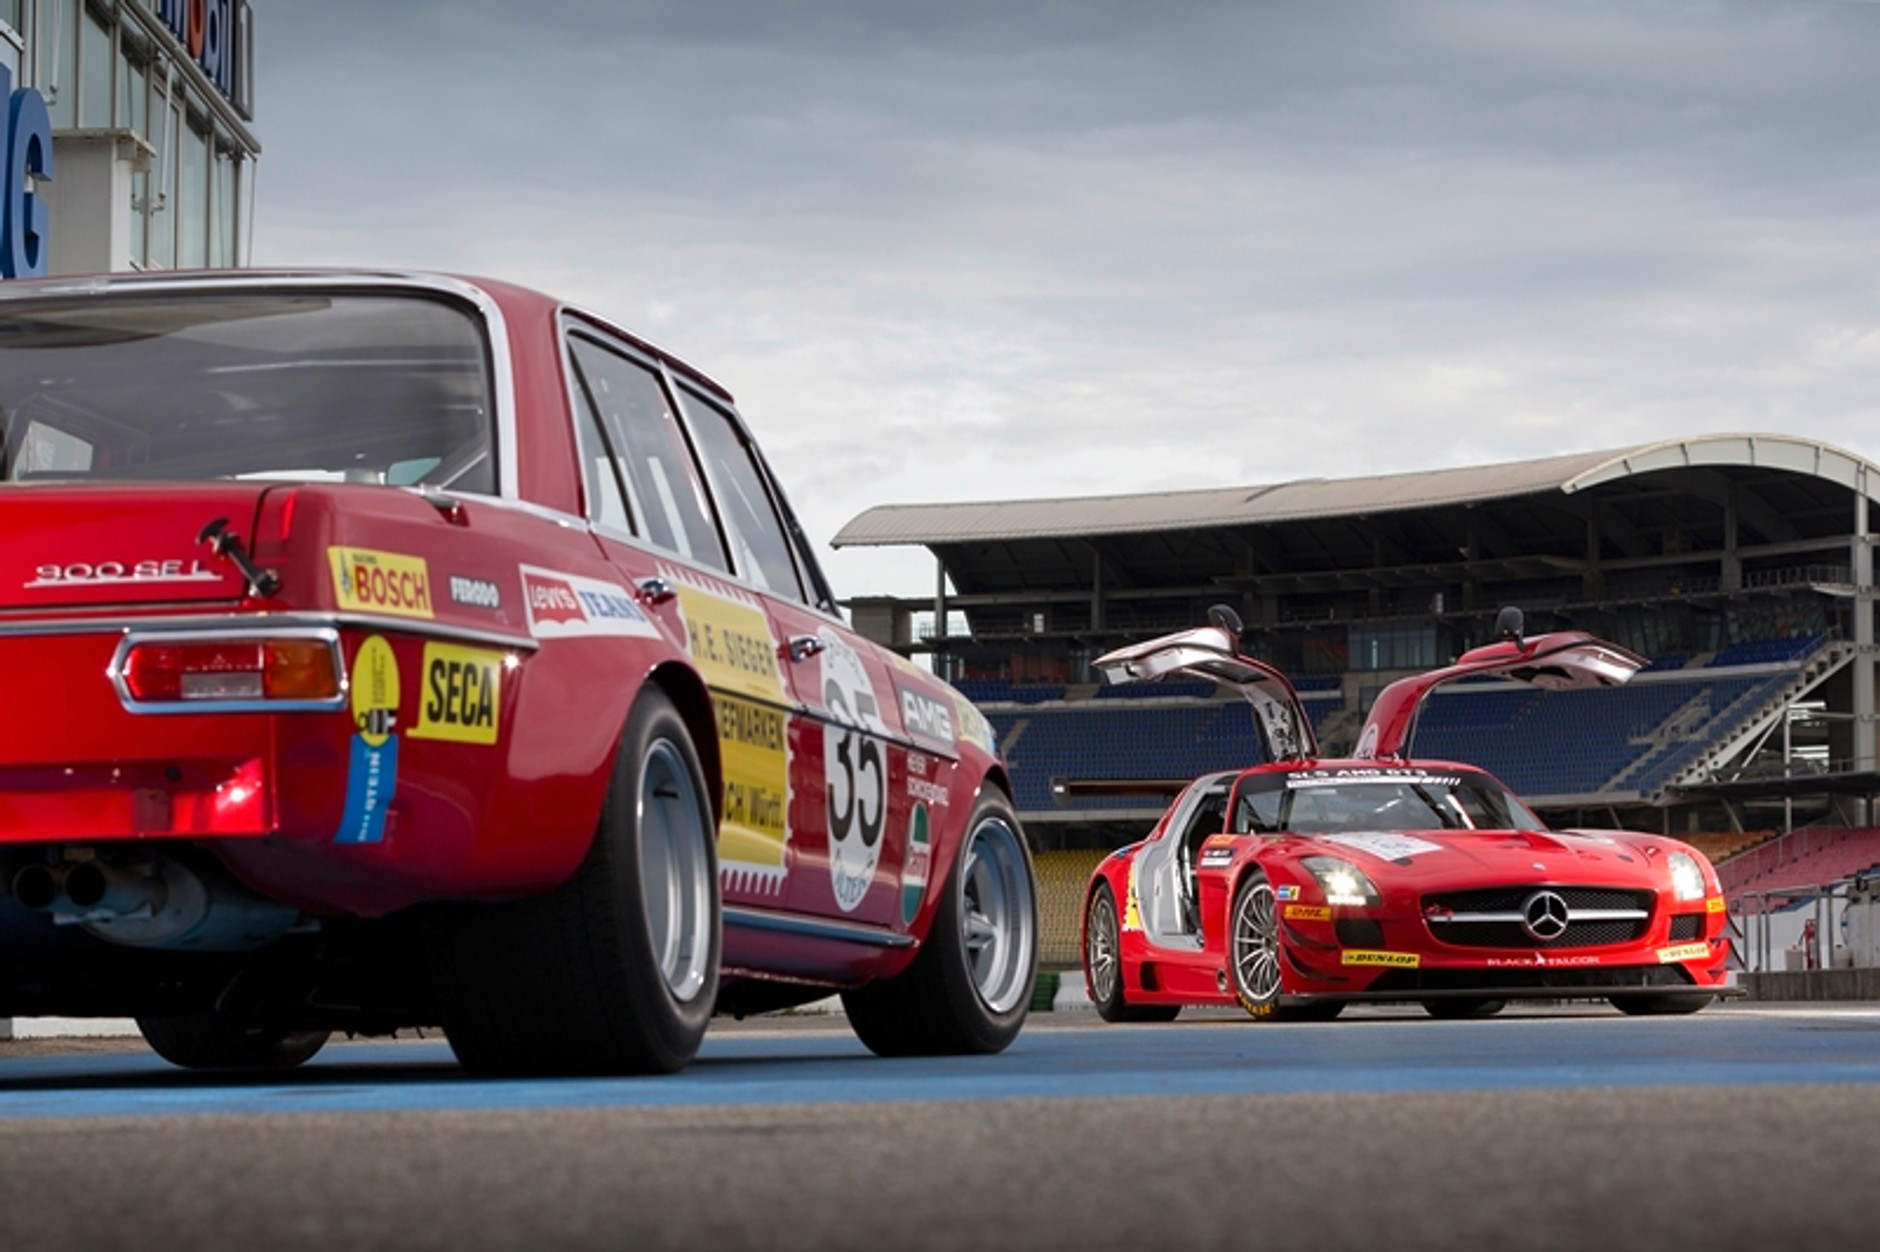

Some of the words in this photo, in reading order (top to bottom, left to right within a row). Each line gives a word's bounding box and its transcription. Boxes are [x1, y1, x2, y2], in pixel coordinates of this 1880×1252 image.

[355, 564, 429, 610] BOSCH
[450, 575, 500, 608] FERODO
[723, 628, 776, 677] SIEGER
[427, 658, 493, 729] SECA
[901, 690, 953, 741] AMG
[825, 677, 884, 848] 35
[1287, 770, 1328, 779] SLS
[1337, 769, 1381, 778] AMG
[1386, 769, 1428, 778] GT3
[1354, 953, 1417, 964] DUNLOP
[1486, 958, 1533, 967] BLACK
[1547, 956, 1600, 966] FALCON
